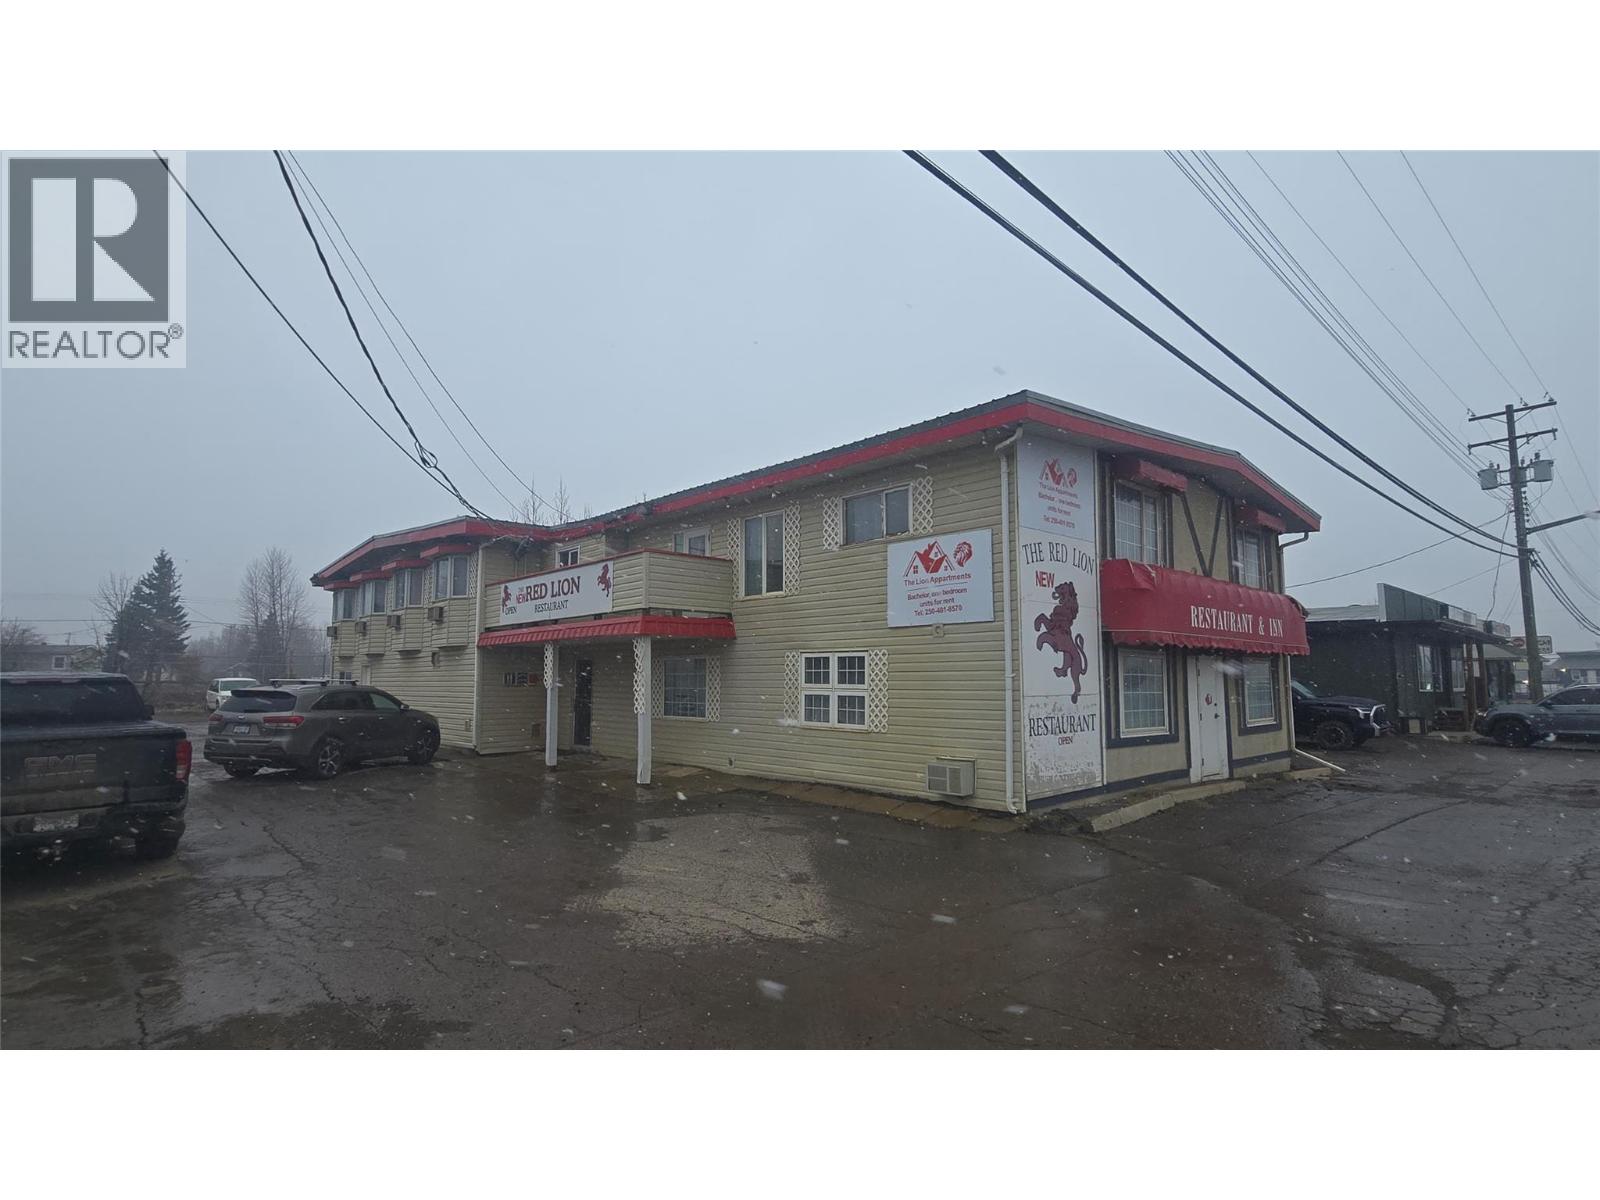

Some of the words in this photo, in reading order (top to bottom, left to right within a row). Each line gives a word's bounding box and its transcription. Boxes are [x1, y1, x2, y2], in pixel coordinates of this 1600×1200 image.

[1022, 542, 1045, 565] THE
[1048, 542, 1068, 563] RED
[1072, 547, 1094, 576] LION
[930, 572, 971, 584] Appartments
[1035, 570, 1055, 588] NEW
[525, 582, 548, 602] RED
[551, 576, 581, 598] LION
[505, 605, 517, 615] OPEN
[534, 600, 568, 613] RESTAURANT
[1190, 605, 1253, 634] RESTAURANT
[1258, 616, 1265, 636] &
[1269, 618, 1283, 638] INN
[1029, 713, 1097, 737] RESTAURANT
[1058, 736, 1073, 746] OPEN
